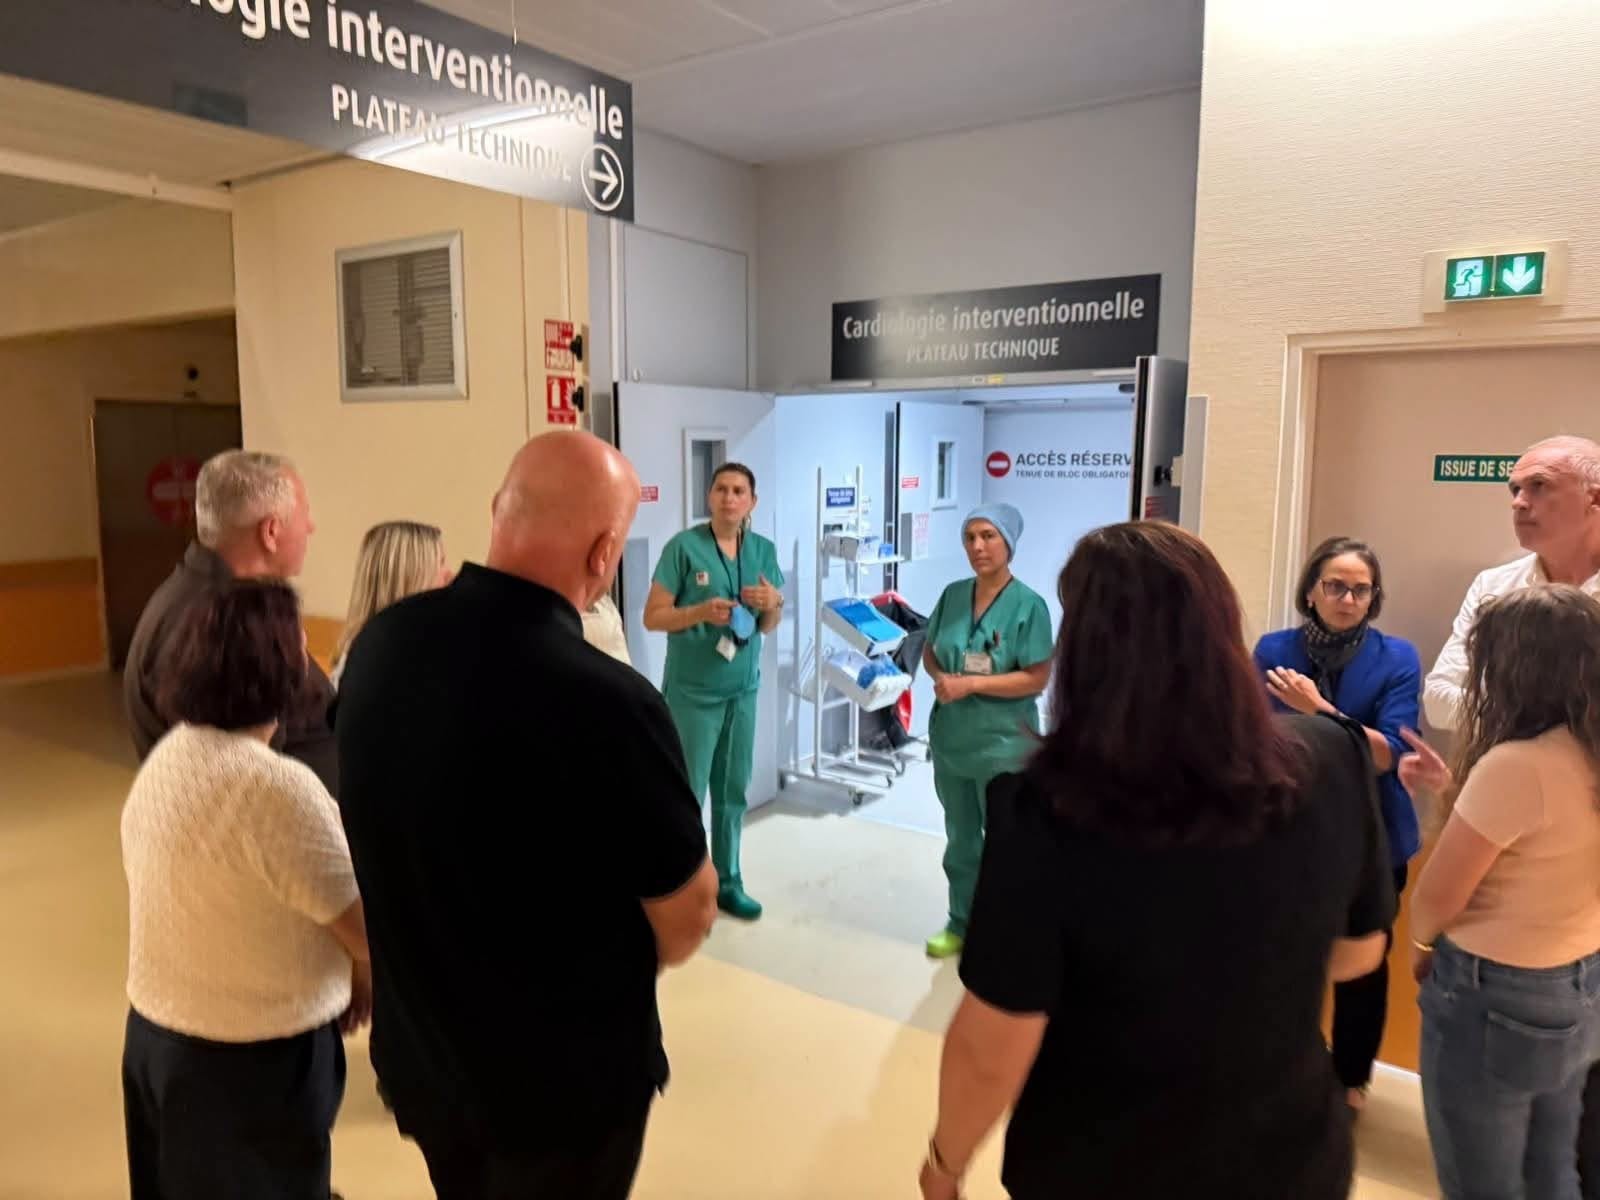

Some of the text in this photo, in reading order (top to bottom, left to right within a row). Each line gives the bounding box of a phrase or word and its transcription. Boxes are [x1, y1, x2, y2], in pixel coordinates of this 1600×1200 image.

[327, 0, 624, 140] interventionnelle
[331, 84, 572, 182] PLATEAU TECHNIQUE
[953, 291, 1145, 331] interventionnelle
[905, 337, 1060, 363] PLATEAU TECHNIQUE
[1016, 450, 1067, 466] ACCÈS
[1440, 460, 1476, 477] ISSUE
[1479, 460, 1496, 477] DE
[1016, 470, 1041, 478] TENUE
[1044, 470, 1055, 478] DE
[1057, 470, 1080, 478] BLOC
